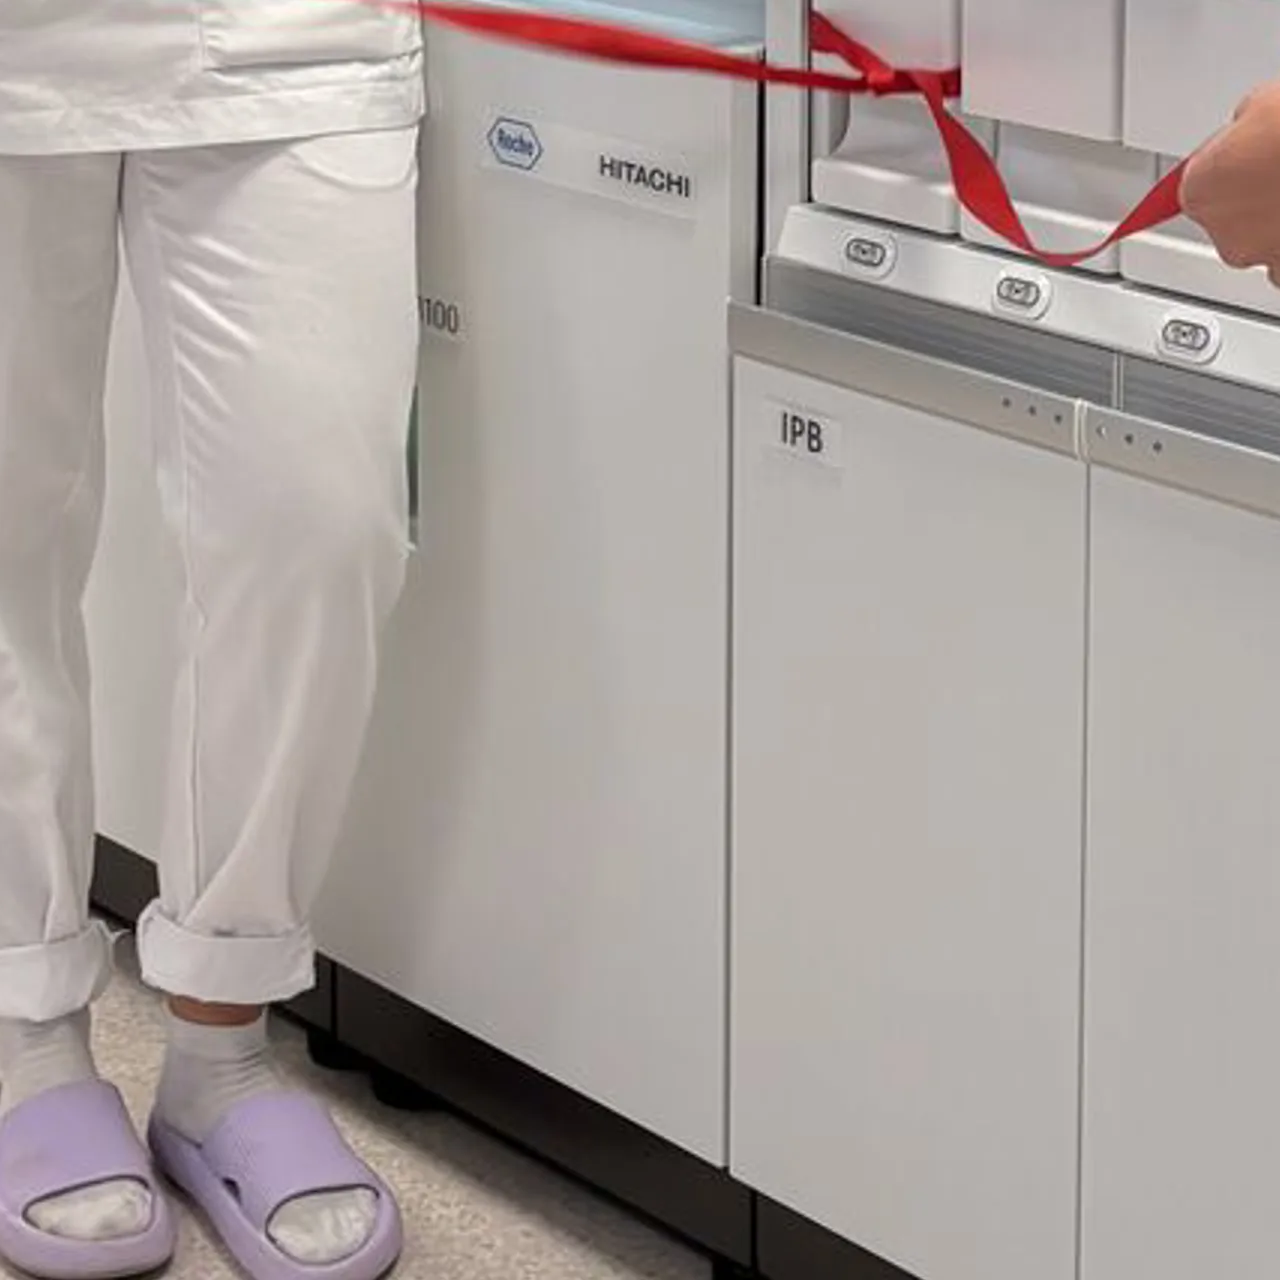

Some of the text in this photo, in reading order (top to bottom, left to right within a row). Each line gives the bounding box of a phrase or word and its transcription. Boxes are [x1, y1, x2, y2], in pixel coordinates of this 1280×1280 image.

[600, 154, 690, 198] HITACHI
[418, 295, 458, 334] 100
[782, 411, 824, 453] IPB
